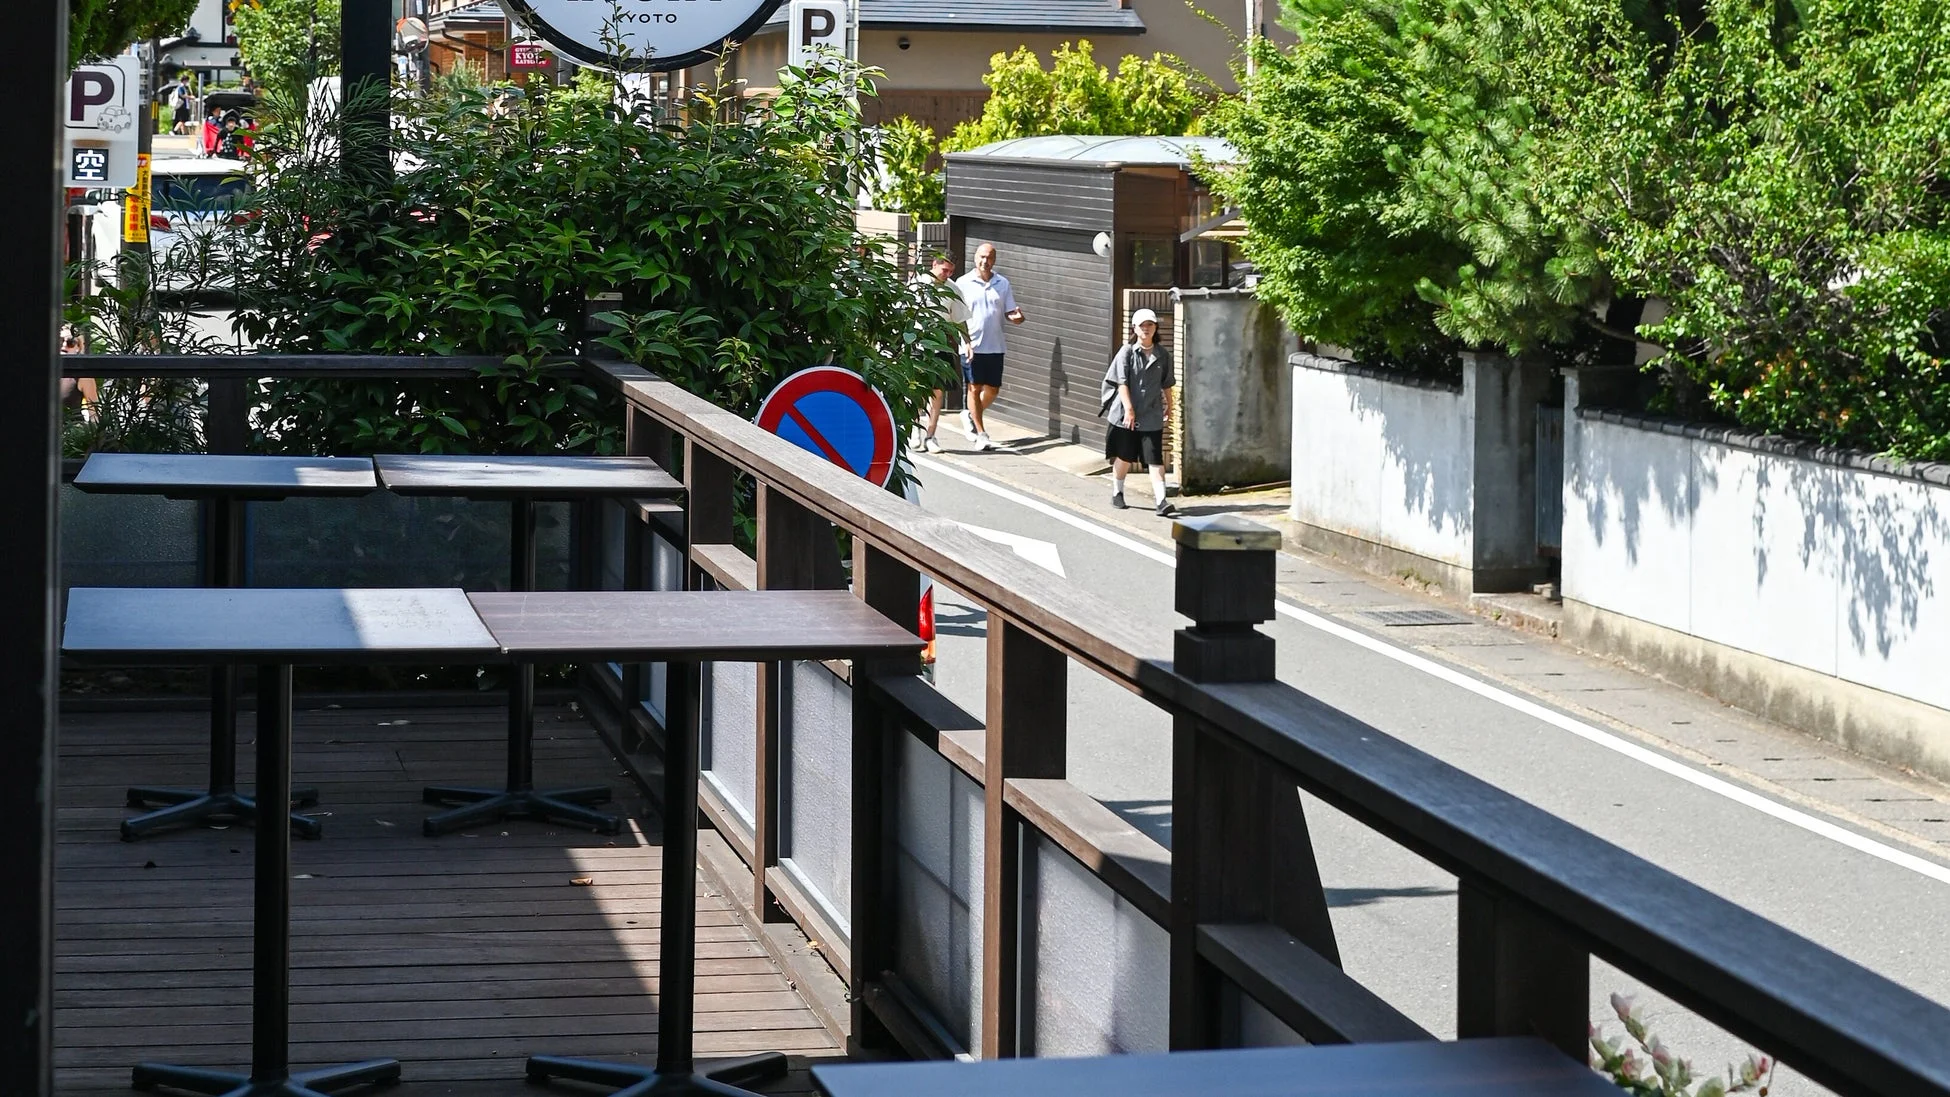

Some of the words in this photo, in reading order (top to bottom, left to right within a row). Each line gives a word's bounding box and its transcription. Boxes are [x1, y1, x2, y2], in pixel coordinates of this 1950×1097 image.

[612, 13, 677, 24] KYOTO
[802, 8, 836, 53] P
[515, 52, 547, 60] KYOT
[70, 71, 115, 122] P
[74, 149, 106, 181] 空
